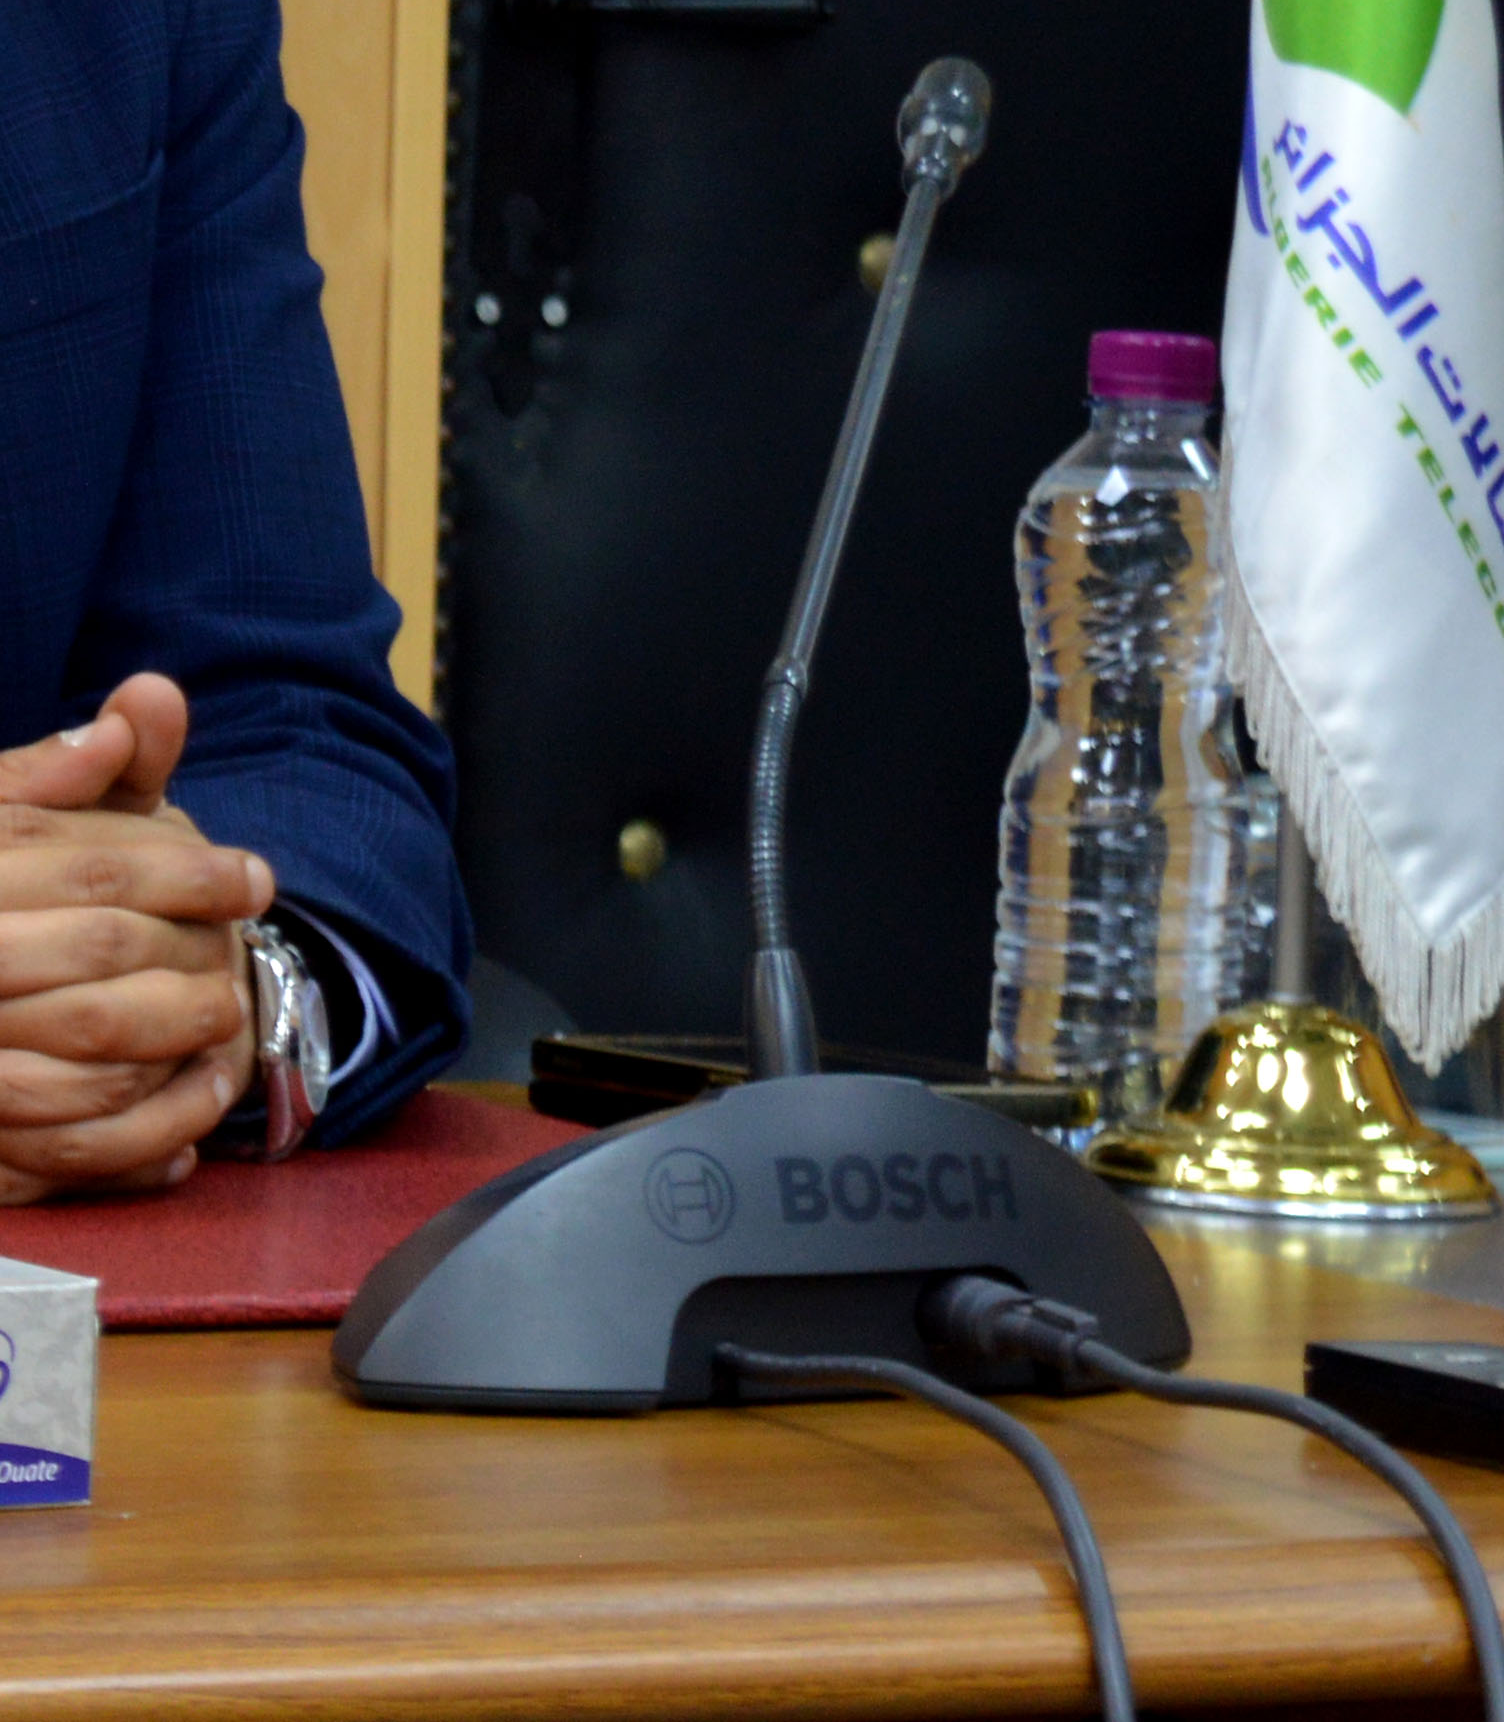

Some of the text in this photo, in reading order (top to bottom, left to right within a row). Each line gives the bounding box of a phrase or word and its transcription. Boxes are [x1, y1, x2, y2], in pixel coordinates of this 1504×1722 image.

[1274, 119, 1439, 341] الجزائر
[1262, 154, 1504, 639] ALGERIE TELEC
[774, 1151, 1019, 1225] BOSCH
